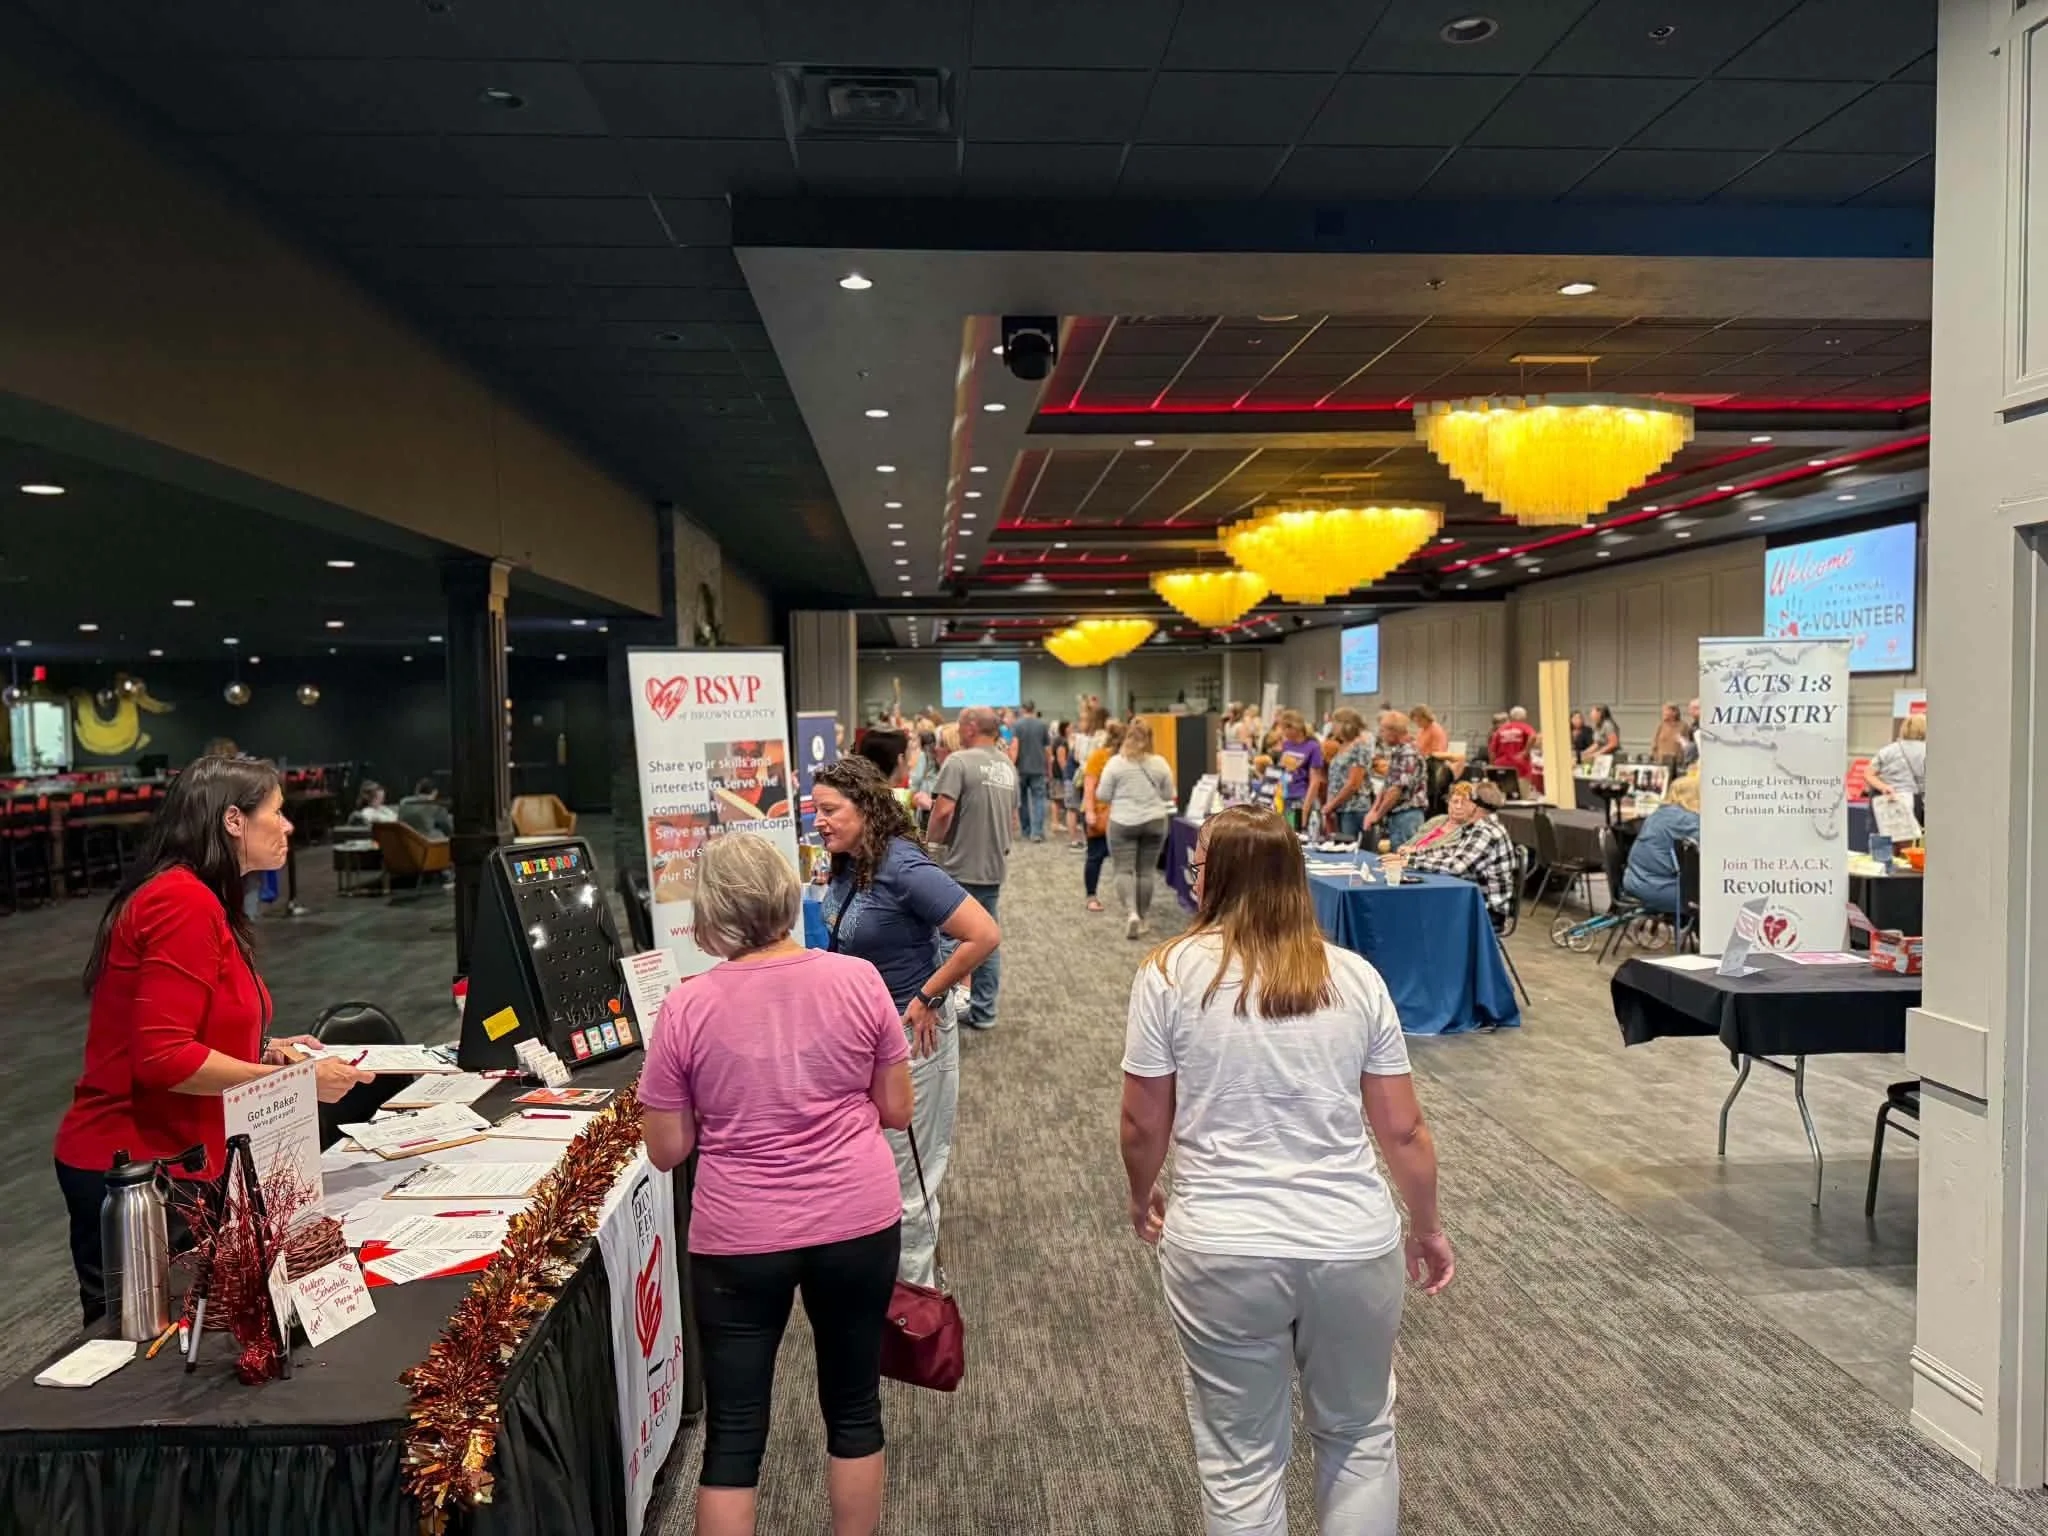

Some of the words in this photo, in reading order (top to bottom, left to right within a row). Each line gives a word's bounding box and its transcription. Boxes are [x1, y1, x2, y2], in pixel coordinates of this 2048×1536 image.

[1812, 603, 1905, 631] VOLUNTEER
[694, 674, 761, 705] RSVP
[1725, 674, 1791, 694] ACTS
[1800, 674, 1832, 693] 1:8
[690, 709, 731, 721] BROWN
[733, 708, 776, 720] COUNTY
[1710, 704, 1838, 724] MINISTRY
[648, 759, 684, 773] Share
[688, 759, 715, 772] your
[719, 756, 746, 769] skills
[750, 756, 771, 767] and
[650, 781, 705, 794] interests
[709, 779, 720, 790] to
[725, 777, 756, 789] serve
[758, 775, 778, 787] the
[1711, 775, 1764, 788] Changing
[1766, 775, 1794, 785] Lives
[1798, 775, 1841, 788] Through
[1735, 791, 1777, 801] Planned
[1781, 791, 1804, 801] Acts
[1807, 790, 1822, 801] Of
[653, 801, 726, 817] community.
[1724, 804, 1774, 816] Christian
[655, 826, 689, 839] Serve
[692, 826, 706, 836] as
[709, 824, 724, 833] an
[726, 819, 794, 832] AmeriCorps
[513, 858, 549, 877] PRIZE
[548, 855, 578, 872] DROP
[1722, 858, 1748, 871] Join
[1752, 858, 1775, 870] The
[1778, 858, 1833, 870] P.A.C.K.
[1723, 877, 1833, 895] Revolution!
[248, 1108, 264, 1122] Got
[266, 1106, 271, 1114] a
[273, 1092, 298, 1112] Rake?
